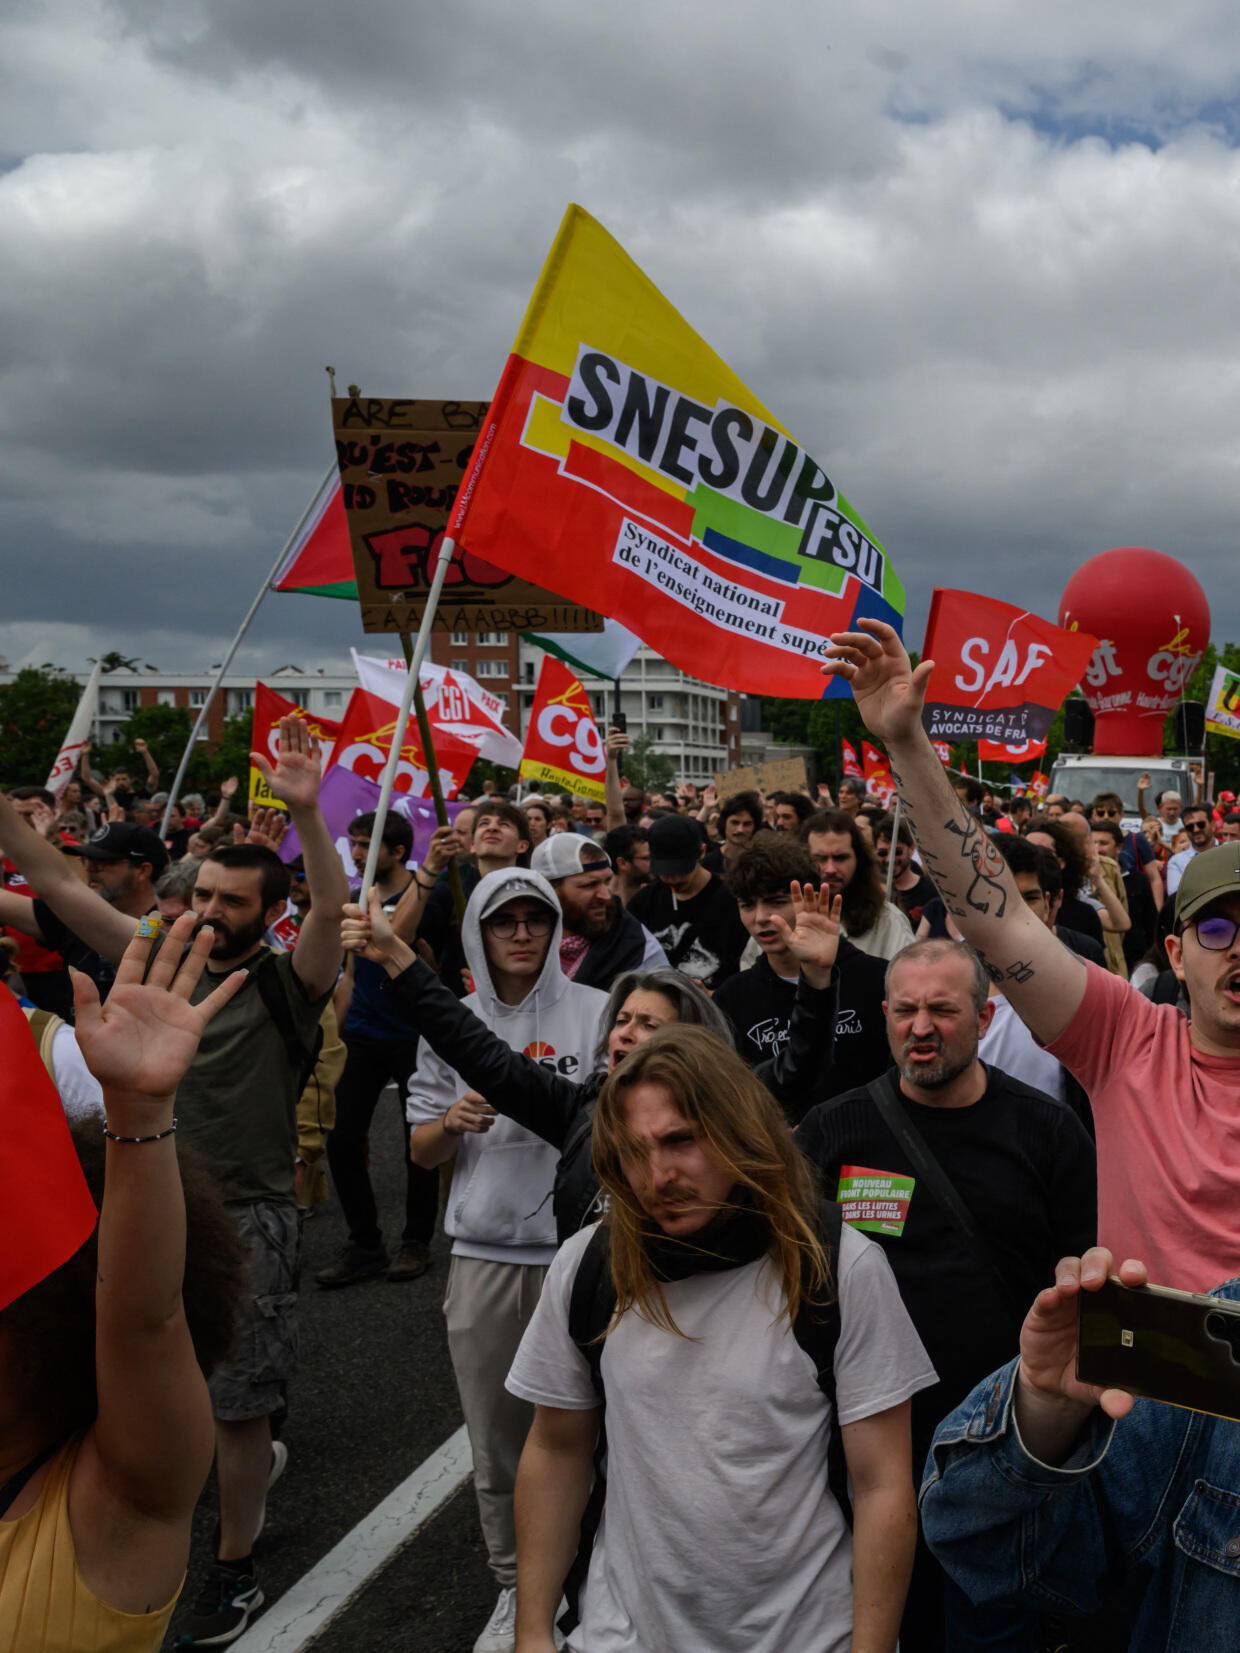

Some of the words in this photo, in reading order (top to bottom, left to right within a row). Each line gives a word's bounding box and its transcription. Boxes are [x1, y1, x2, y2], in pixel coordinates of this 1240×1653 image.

[568, 352, 836, 526] SNESUP
[805, 507, 880, 585] FSU
[618, 546, 641, 569] de
[623, 521, 700, 582] Syndicat
[702, 577, 783, 619] national
[387, 659, 407, 671] PAI
[955, 635, 1053, 694] SAF
[931, 709, 1017, 727] SYNDICAT
[930, 722, 984, 735] AVOCATS
[985, 724, 1002, 737] DE
[852, 1179, 893, 1189] NOUVEAU
[862, 1189, 912, 1199] POPULAIRE
[858, 1201, 871, 1211] LES
[871, 1201, 899, 1211] LUTTES
[862, 1210, 876, 1219] LES
[876, 1210, 902, 1220] URNES
